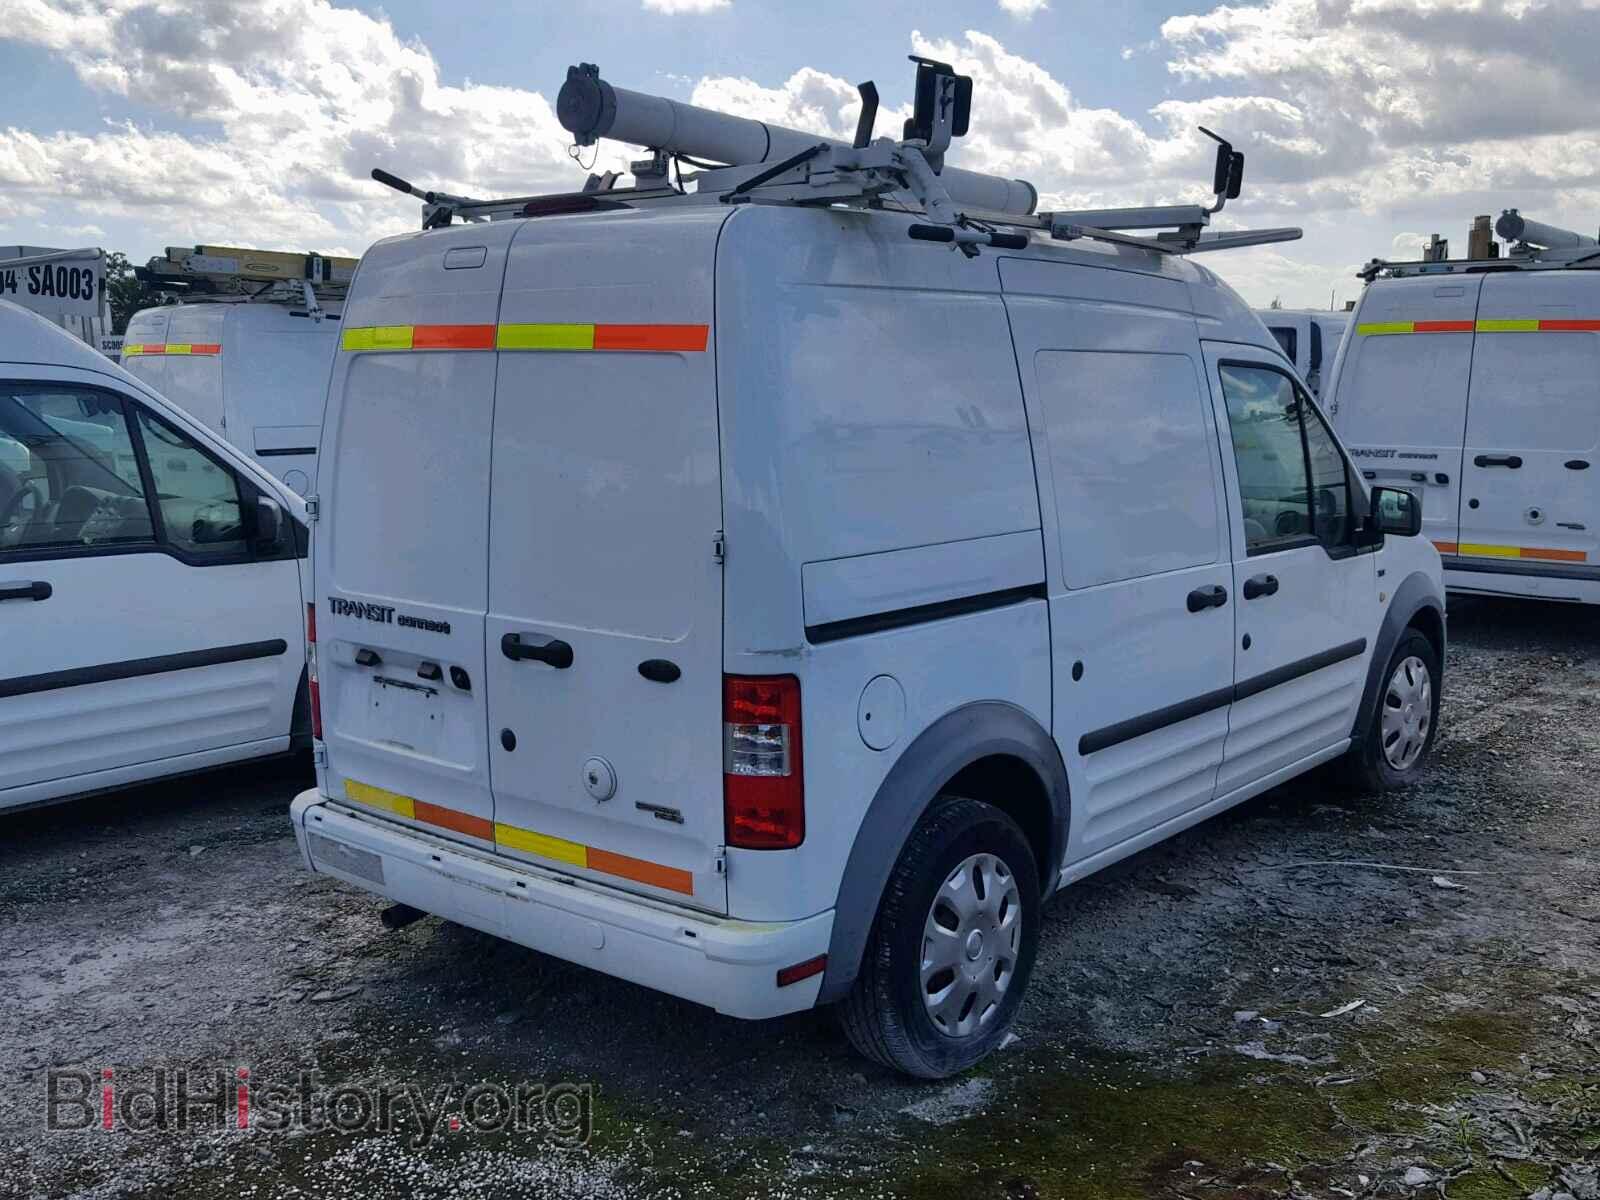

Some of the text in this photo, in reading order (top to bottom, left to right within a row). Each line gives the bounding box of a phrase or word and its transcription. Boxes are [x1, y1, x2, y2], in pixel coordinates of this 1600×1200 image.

[28, 264, 93, 300] SA003
[328, 596, 451, 634] TRANSIT connect
